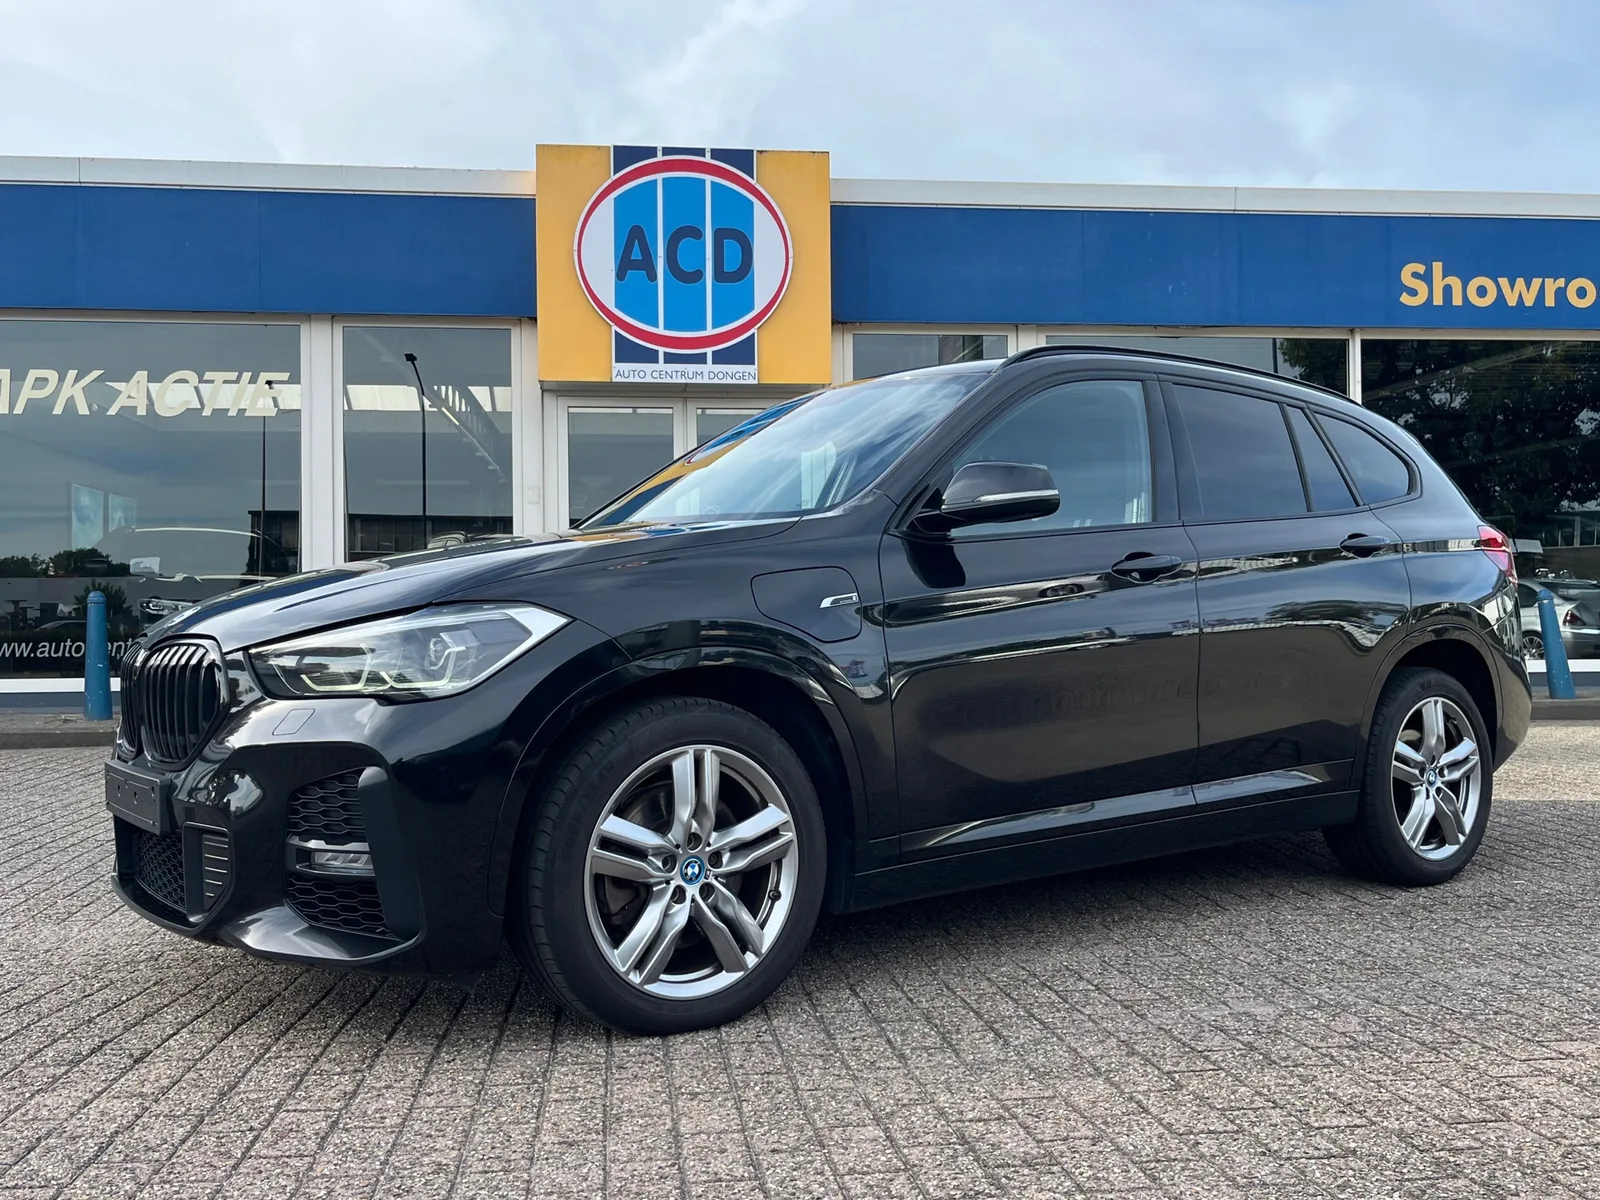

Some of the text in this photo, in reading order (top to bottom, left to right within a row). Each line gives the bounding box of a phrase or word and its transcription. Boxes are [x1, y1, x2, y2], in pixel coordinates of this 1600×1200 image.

[616, 225, 753, 285] ACD
[1400, 262, 1600, 309] Showro
[106, 370, 290, 417] ACTIE
[615, 369, 756, 381] AUTO CENTRUM DONGEN
